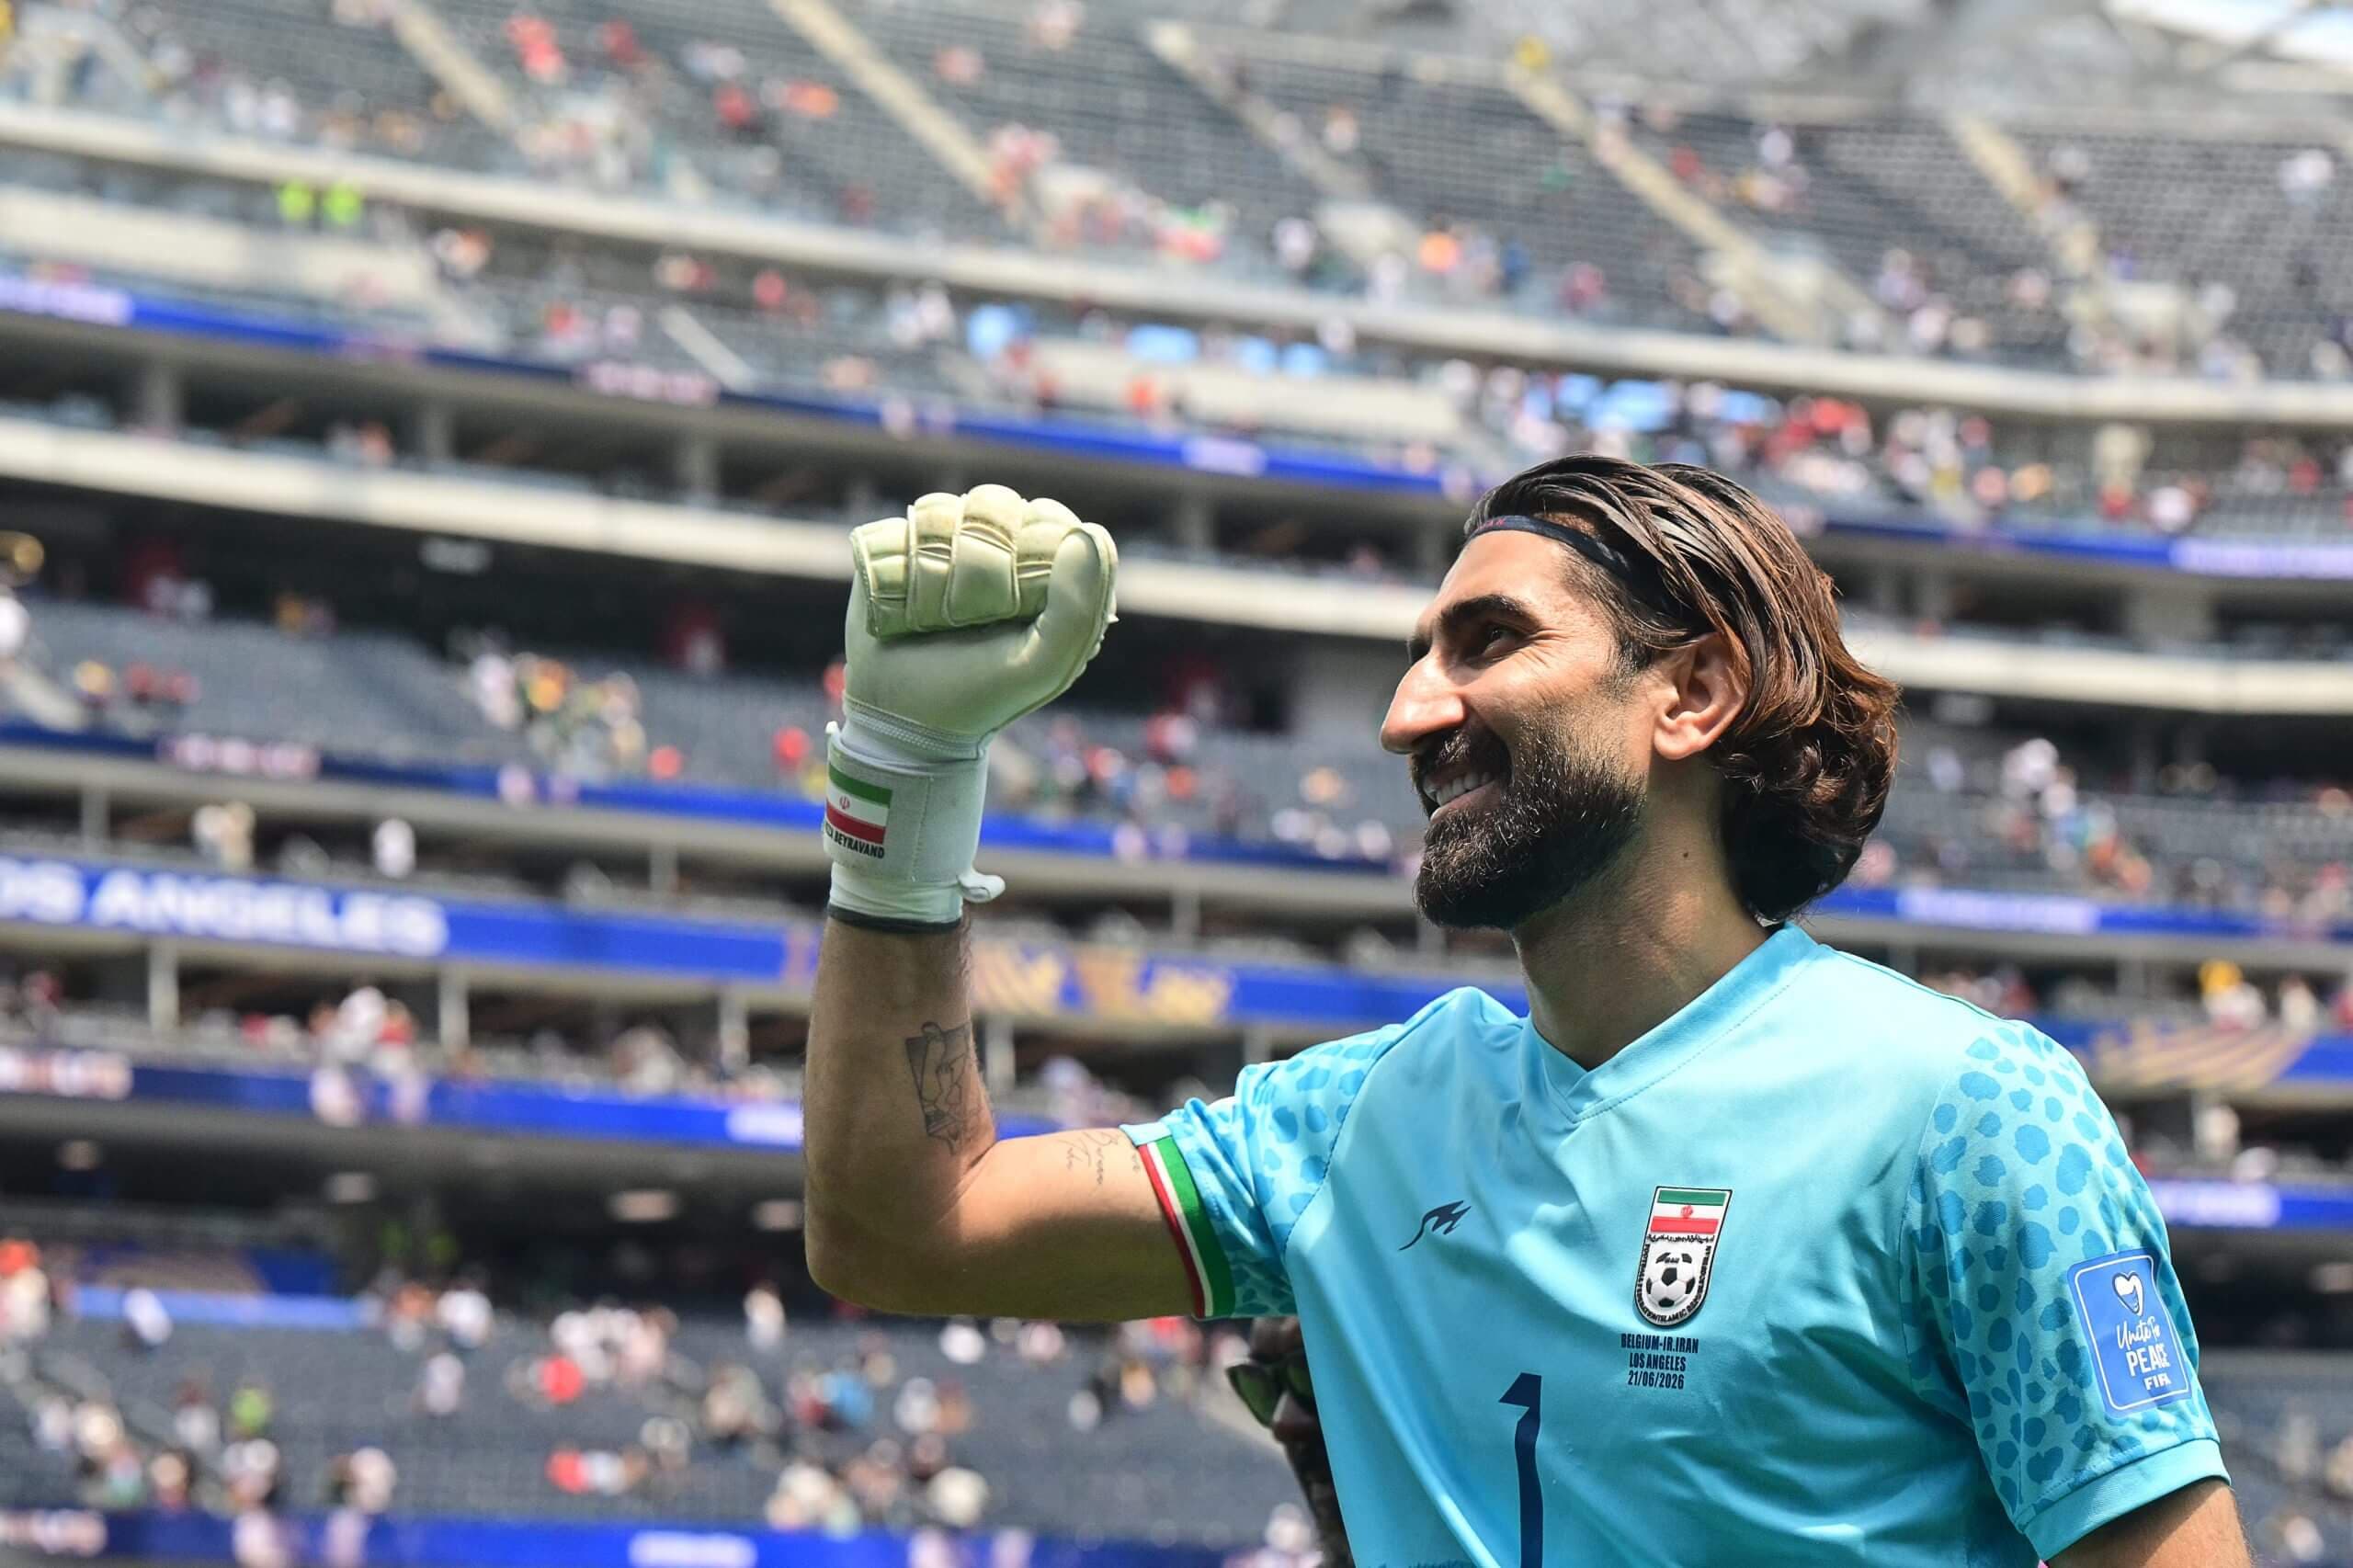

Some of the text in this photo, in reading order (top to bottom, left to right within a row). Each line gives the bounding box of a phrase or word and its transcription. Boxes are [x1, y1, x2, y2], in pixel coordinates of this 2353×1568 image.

[834, 830, 884, 859] BEYRAVAND
[90, 869, 449, 957] ANGELES
[1620, 1333, 1699, 1354] BELGIUM-IR.IRAN
[1629, 1352, 1687, 1372] LOS ANGELES
[1627, 1369, 1685, 1391] 21/06/2026
[1498, 1372, 1543, 1568] 1
